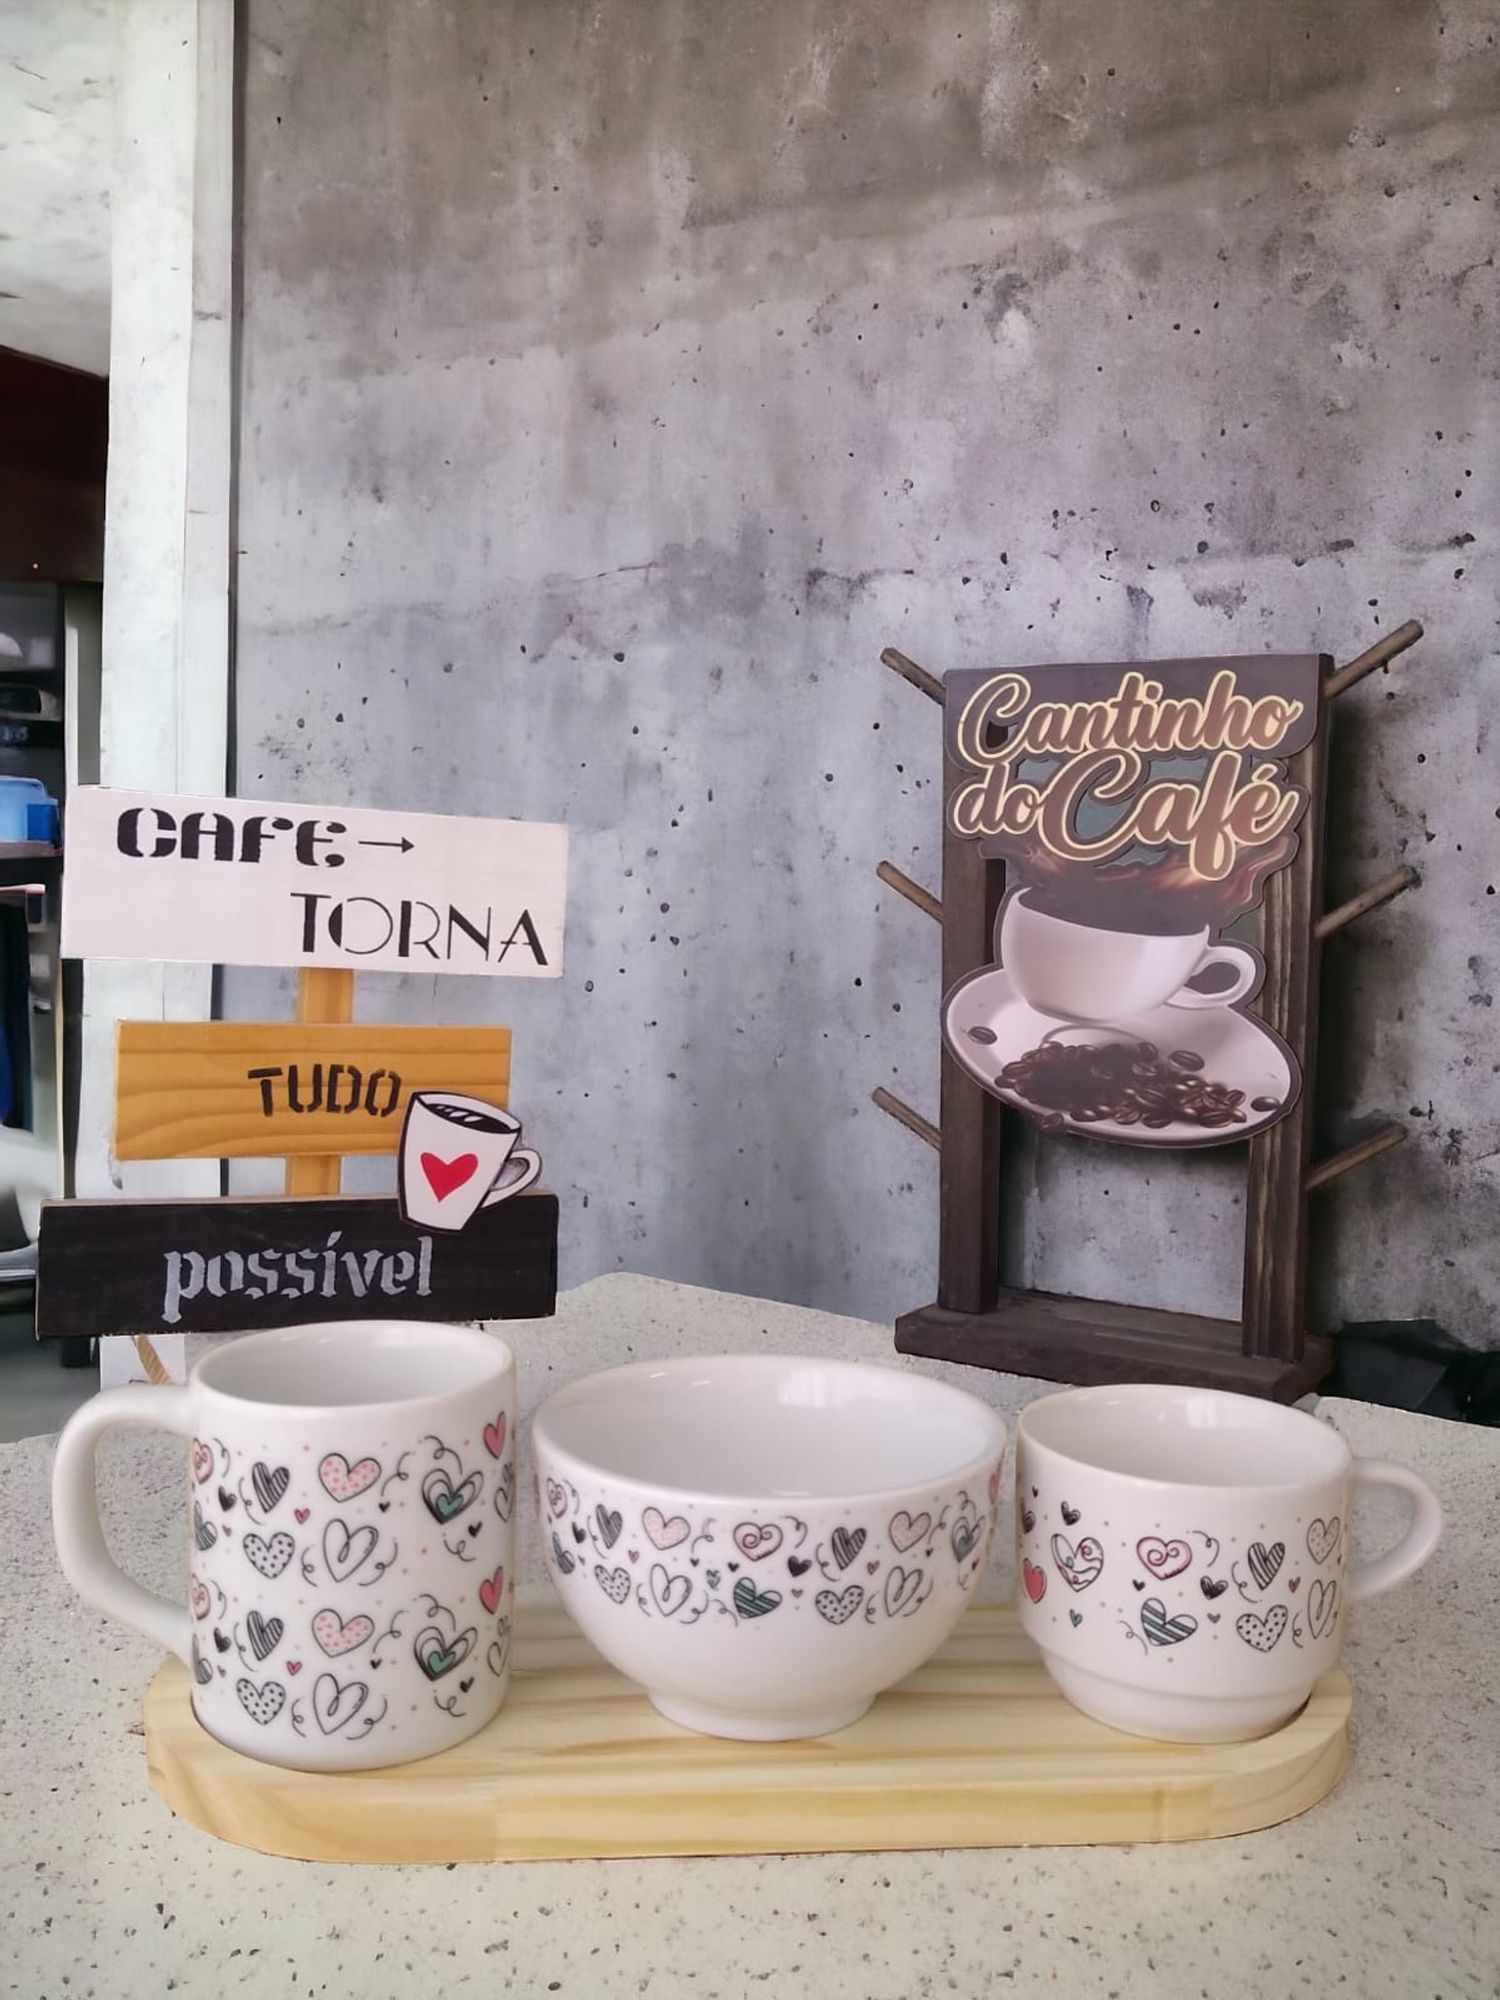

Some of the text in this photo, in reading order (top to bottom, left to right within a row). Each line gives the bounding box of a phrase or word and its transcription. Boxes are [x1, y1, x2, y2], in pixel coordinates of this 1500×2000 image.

[958, 670, 1303, 767] Cantinho
[116, 807, 347, 868] CAFE
[953, 747, 1300, 881] do Café
[290, 892, 549, 966] TORNA
[247, 1063, 402, 1118] TUDO
[161, 1230, 434, 1324] possível
